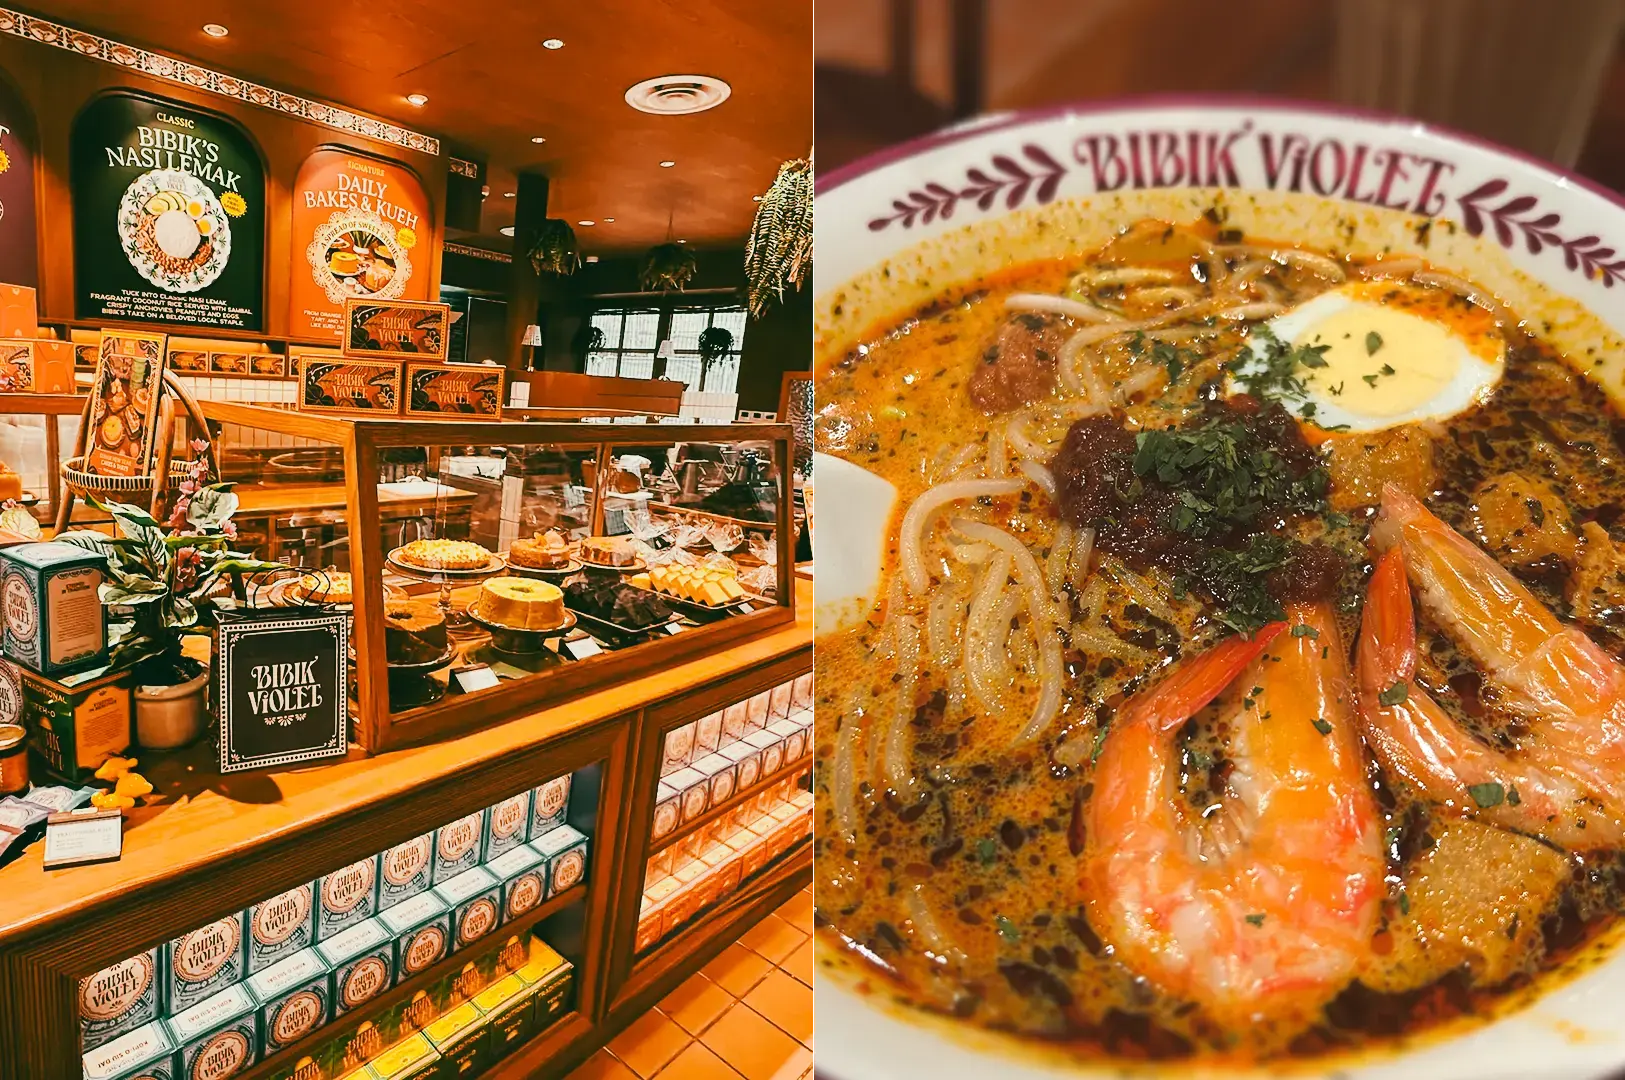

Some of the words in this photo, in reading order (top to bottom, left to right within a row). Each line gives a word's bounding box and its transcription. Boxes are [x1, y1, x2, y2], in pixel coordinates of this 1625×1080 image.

[156, 112, 195, 129] CLASSIC
[137, 126, 219, 163] BIBIK'S
[1073, 117, 1254, 193] BIBIK
[104, 146, 162, 169] NASI
[166, 151, 242, 193] LEMAK
[347, 160, 385, 177] SIGNATURE
[337, 173, 388, 200] DAILY
[304, 190, 358, 209] BAKES
[360, 196, 372, 212] &
[376, 199, 419, 230] KUEH
[324, 223, 348, 244] SPREAD
[358, 222, 380, 235] SWEET
[90, 292, 130, 303] FRAGRANT
[132, 297, 165, 306] COCONUT
[184, 302, 210, 311] SERVED
[211, 304, 226, 312] WITH
[121, 289, 139, 297] TUCK
[141, 291, 158, 299] INTO
[160, 293, 187, 302] CLASSIC
[189, 296, 204, 304] NASI
[101, 308, 125, 316] BIBIK'S
[127, 310, 145, 318] TAKE
[166, 313, 196, 322] BELOVED
[198, 316, 218, 324] LOCAL
[106, 301, 132, 310] CRISPY
[175, 308, 206, 317] PEANUTS
[320, 311, 342, 319] ORANGE
[381, 316, 413, 330] BIBIK
[335, 373, 367, 387] BIBIK
[439, 379, 471, 392] BIBIK
[250, 655, 319, 689] BIBIK
[23, 678, 68, 704] TRADITIONAL
[34, 703, 56, 718] TEH-O
[336, 867, 363, 888] BIBIK
[267, 895, 298, 919] BIBIK
[190, 927, 225, 955] BIBIK
[94, 963, 136, 993] BIBIK
[129, 1002, 143, 1013] DAI
[494, 1000, 532, 1027] TRADITIONAL
[345, 1021, 381, 1053] BIBIK
[445, 1029, 487, 1057] TRADITIONAL
[97, 1058, 111, 1068] DAI
[111, 1052, 123, 1061] SIU
[205, 1042, 236, 1067] BIBIK
